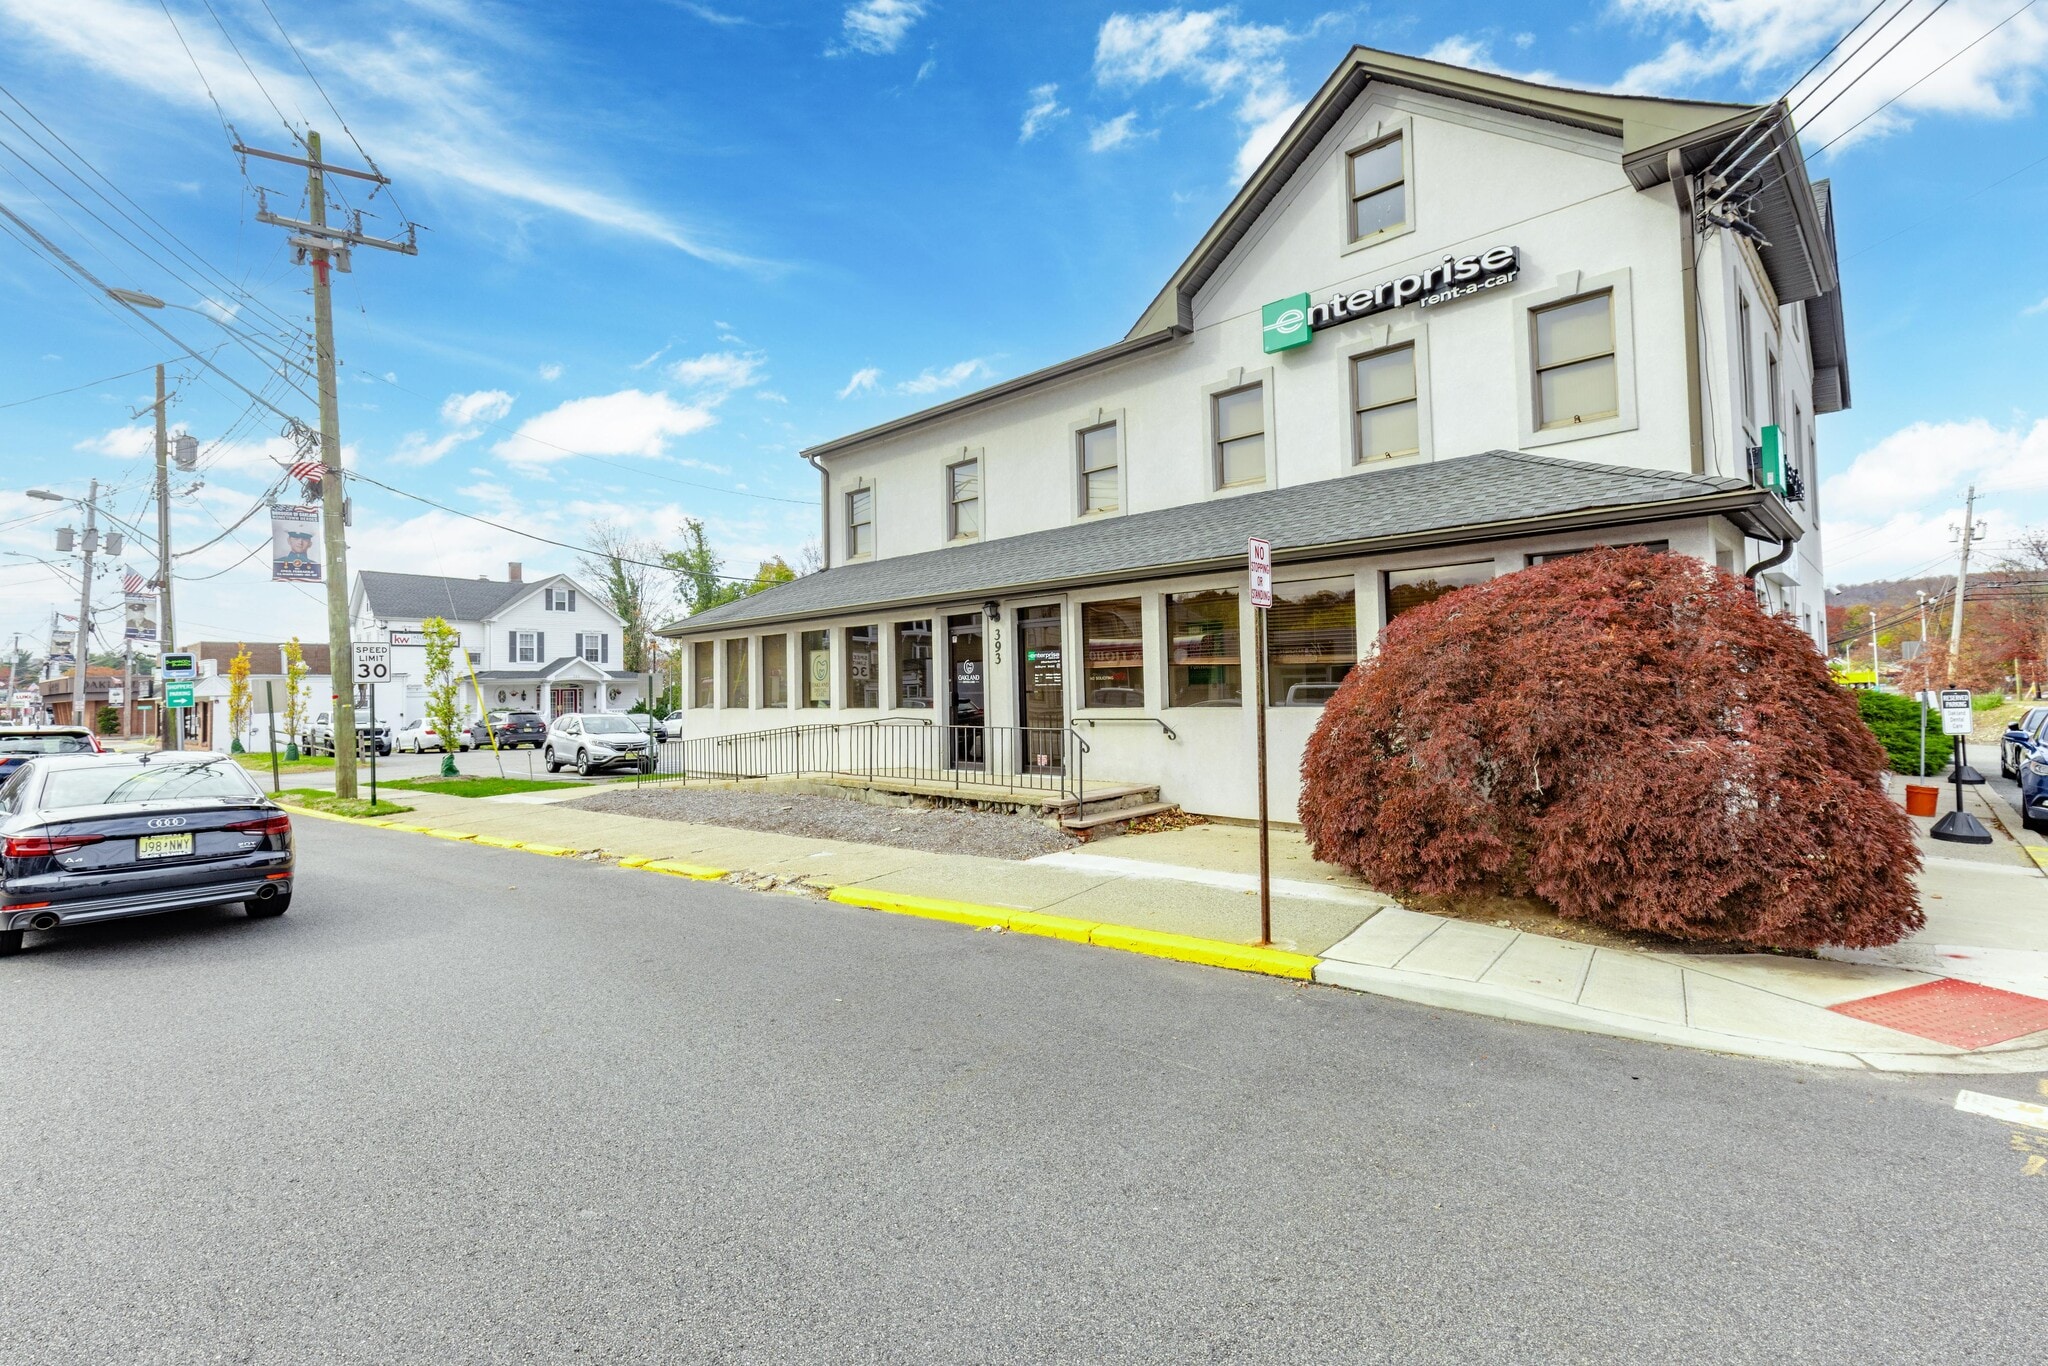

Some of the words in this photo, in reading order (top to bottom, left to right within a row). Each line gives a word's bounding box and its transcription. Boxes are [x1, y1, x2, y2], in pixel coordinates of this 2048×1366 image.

[1263, 245, 1515, 334] enterprise
[1420, 270, 1518, 308] rent-a-car
[1254, 545, 1265, 560] NO
[1251, 561, 1270, 574] STOPPING
[1251, 588, 1270, 601] STANDING
[394, 634, 410, 643] kw
[355, 646, 388, 654] SPEED
[994, 628, 1002, 665] 393
[357, 663, 387, 678] 30
